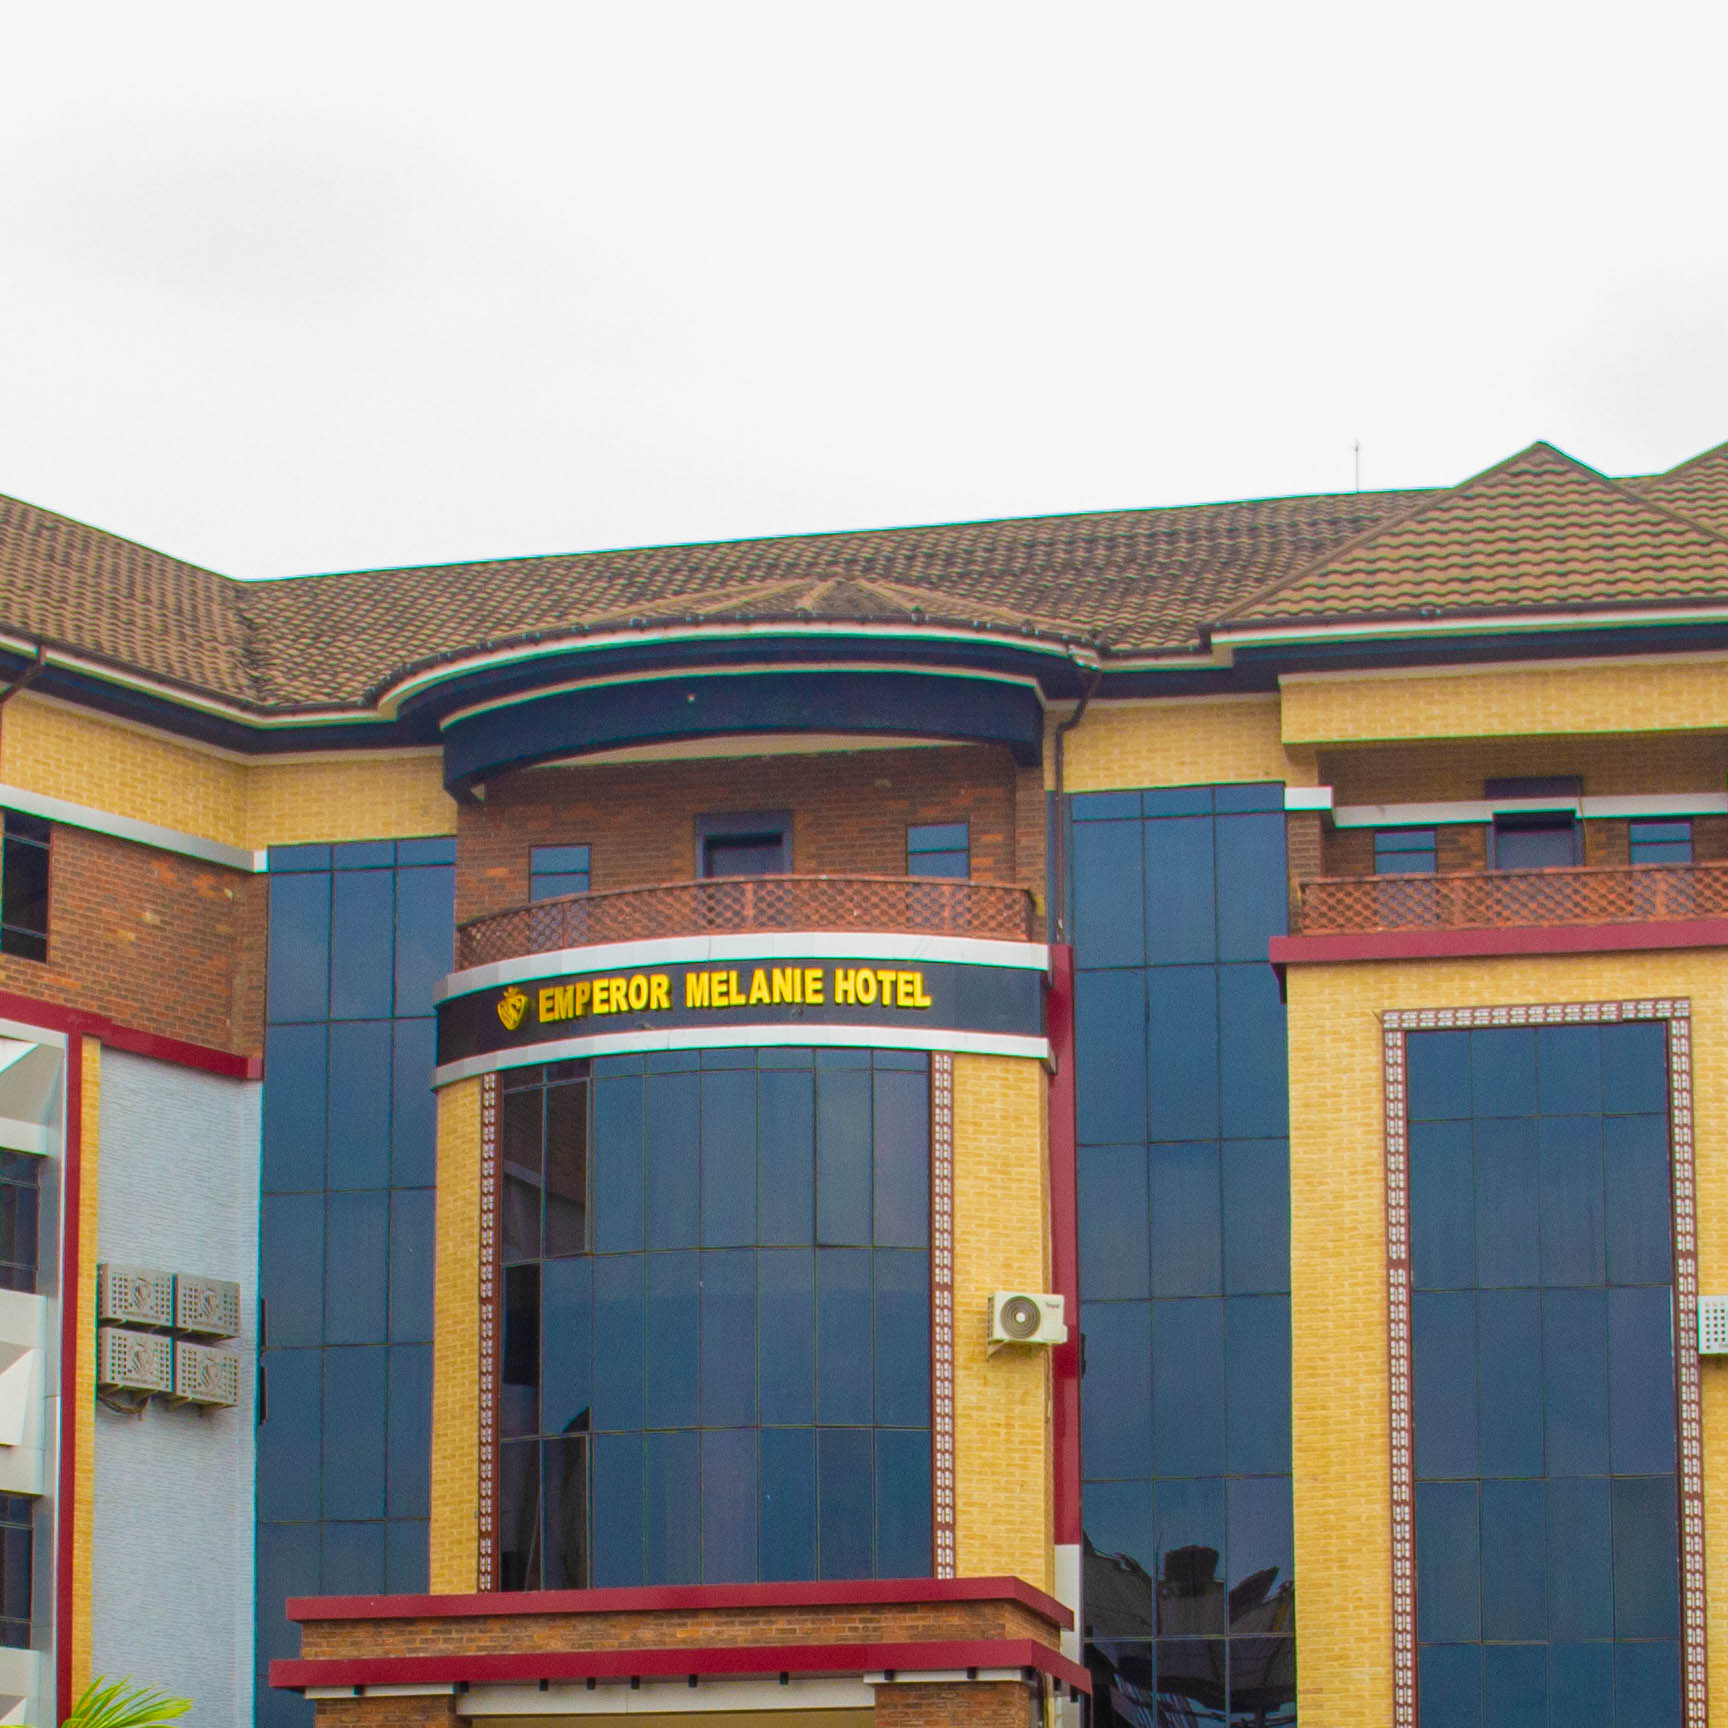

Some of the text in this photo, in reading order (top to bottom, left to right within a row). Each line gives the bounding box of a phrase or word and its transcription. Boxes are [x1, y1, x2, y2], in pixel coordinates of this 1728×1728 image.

[538, 966, 933, 1023] EMPEROR MELANIE HOTEL
